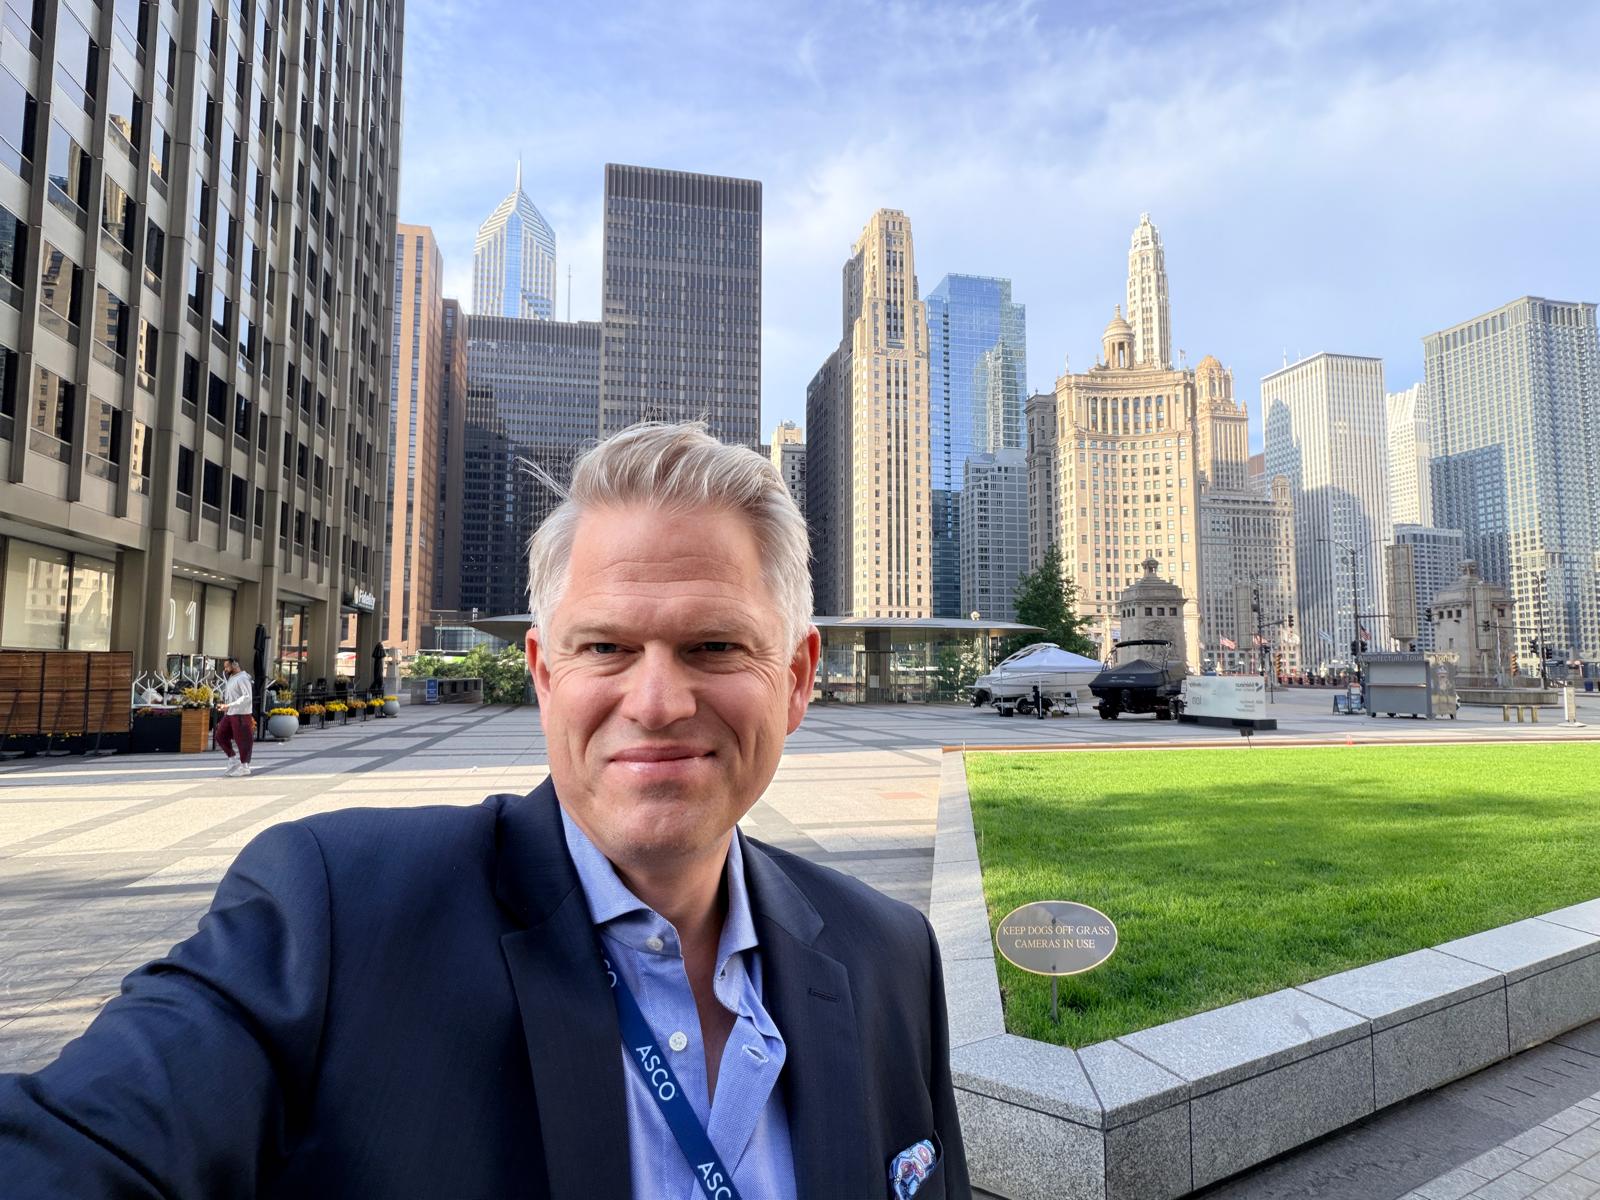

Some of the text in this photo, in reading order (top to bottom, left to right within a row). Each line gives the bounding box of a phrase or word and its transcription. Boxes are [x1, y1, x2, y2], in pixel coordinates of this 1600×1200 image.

[1003, 925, 1110, 935] KEEP DOGS OFF GRASS
[1015, 939, 1096, 949] CAMERAS IN USE
[636, 1045, 676, 1101] ASCO
